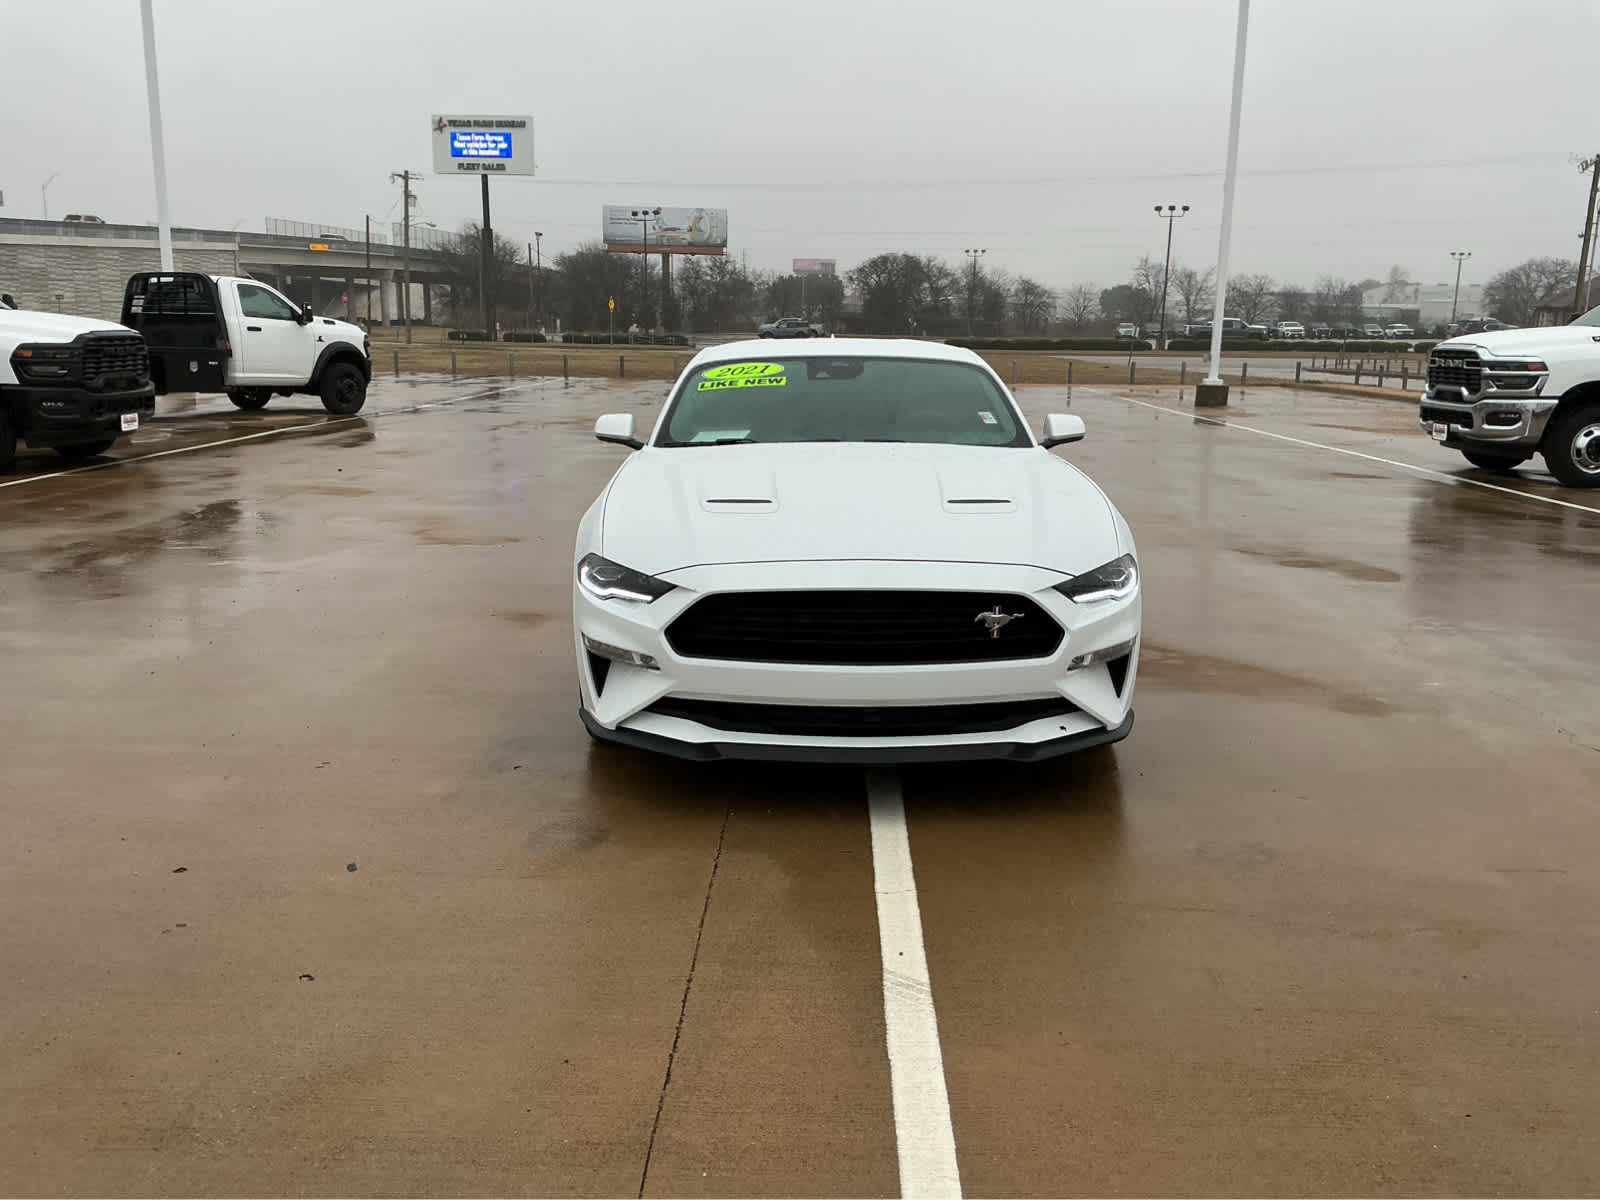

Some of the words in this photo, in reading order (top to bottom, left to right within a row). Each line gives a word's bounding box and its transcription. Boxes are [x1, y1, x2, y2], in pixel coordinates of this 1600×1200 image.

[447, 120, 472, 128] TEXAS
[481, 163, 506, 171] SALES
[1439, 359, 1464, 368] RAM
[717, 365, 770, 377] 2021
[700, 380, 739, 389] LIKE
